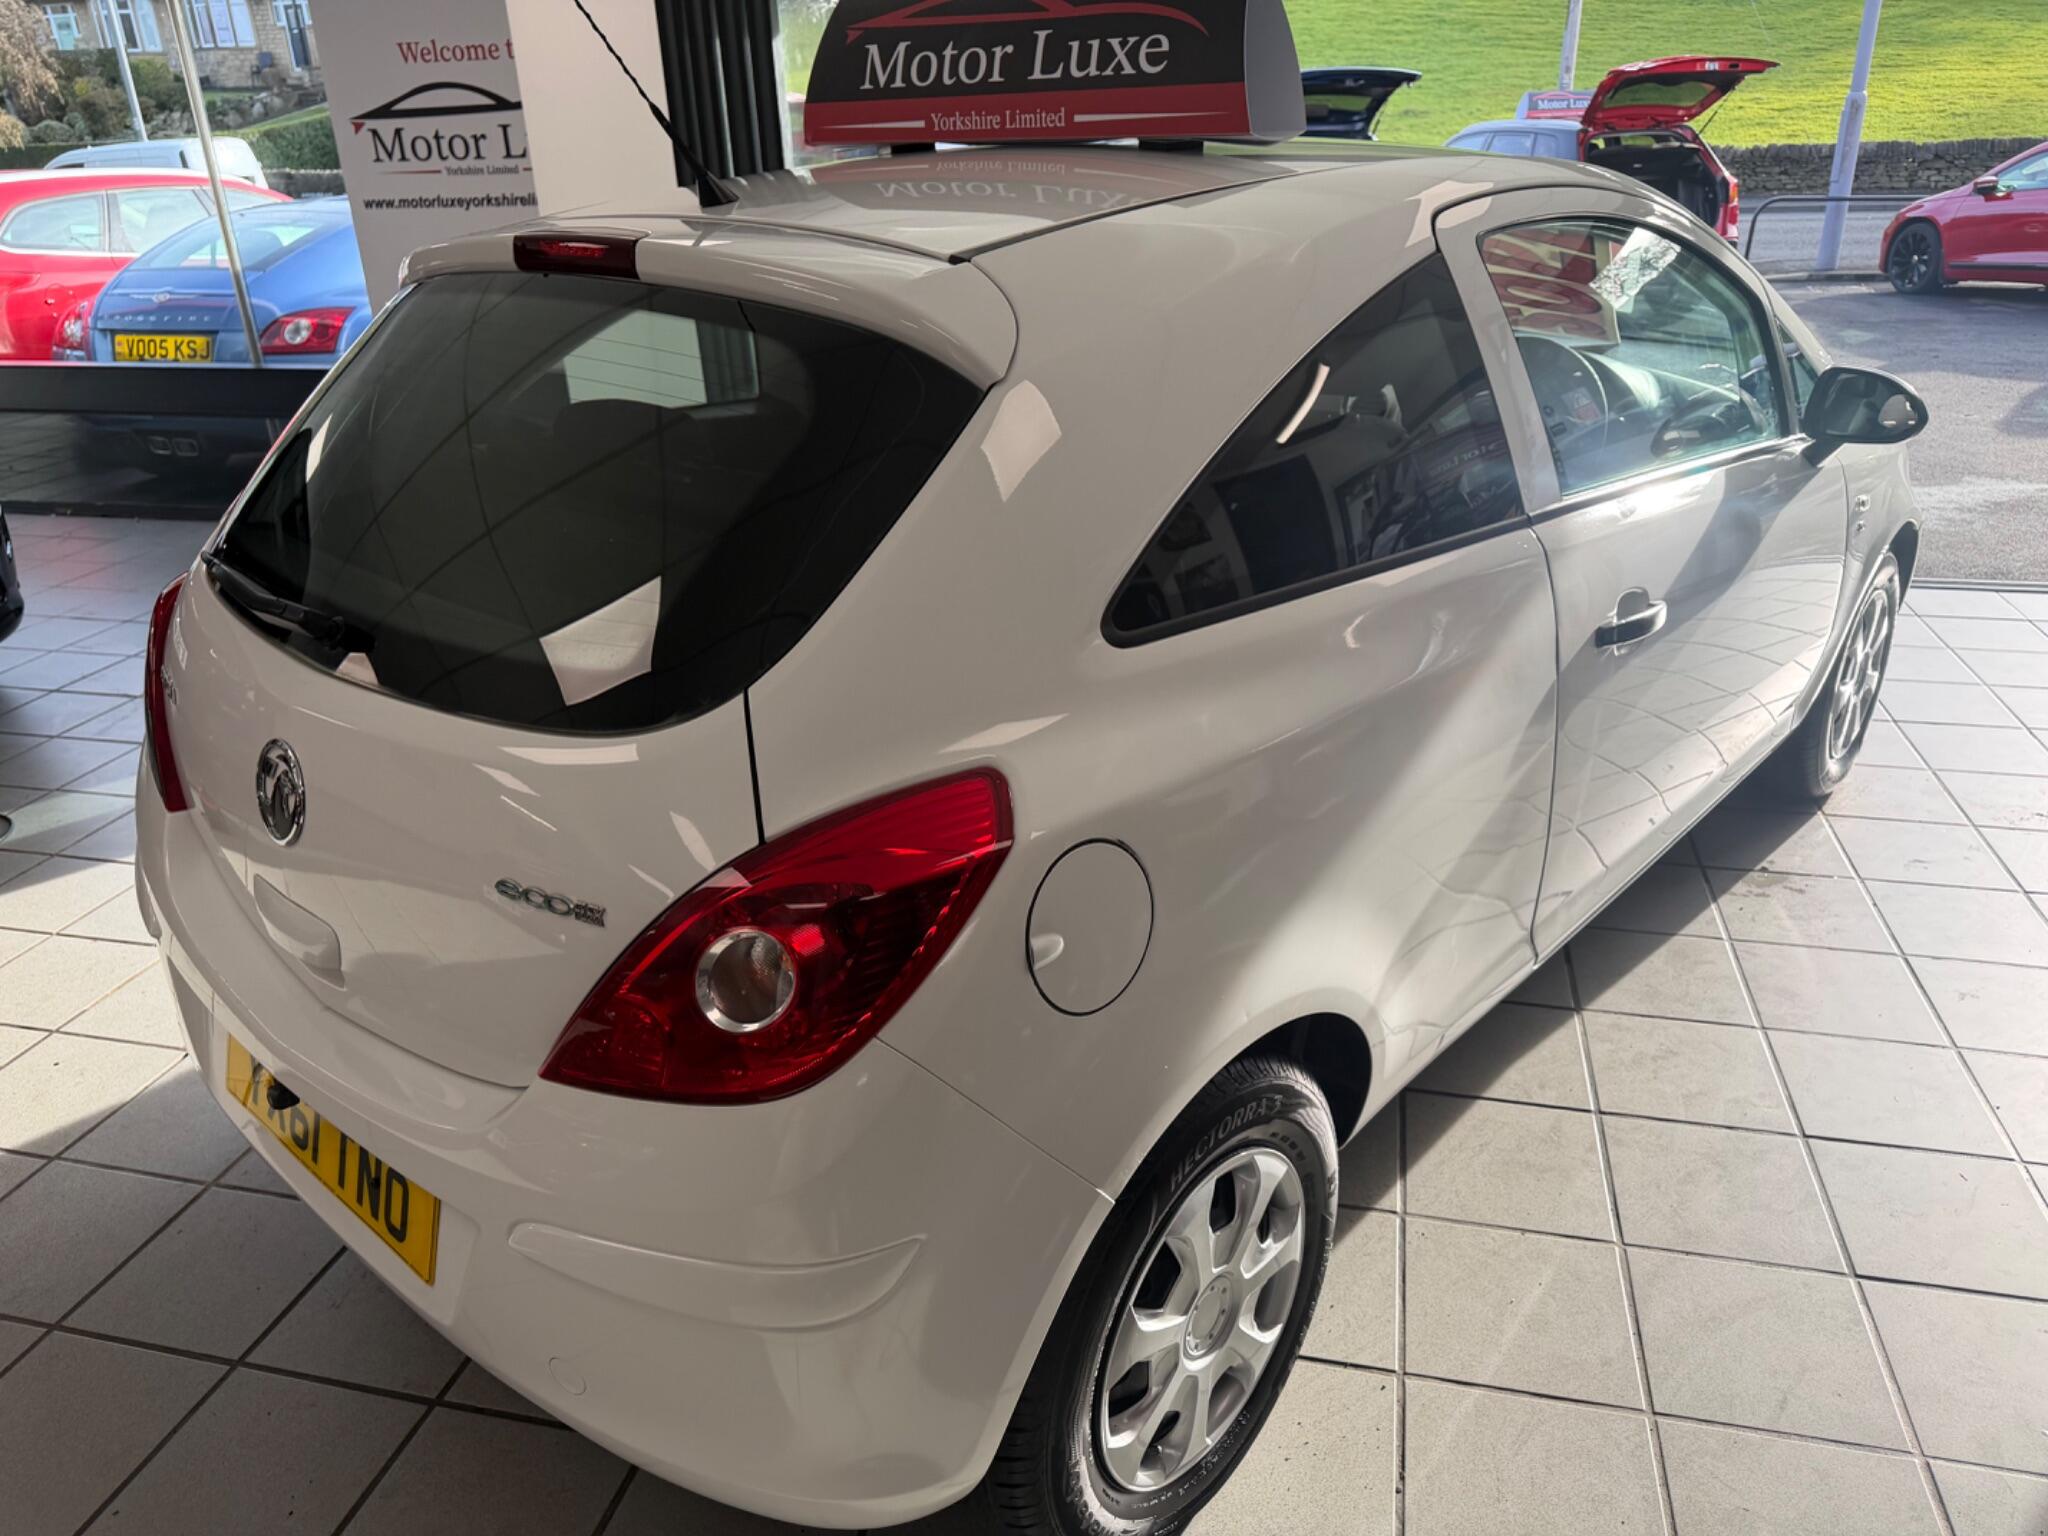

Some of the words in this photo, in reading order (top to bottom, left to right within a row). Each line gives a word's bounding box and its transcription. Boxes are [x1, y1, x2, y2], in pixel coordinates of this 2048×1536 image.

[396, 38, 500, 64] Welcome
[860, 41, 1014, 90] Motor
[1028, 29, 1170, 80] Luxe
[1537, 98, 1568, 110] Motor
[931, 111, 1000, 132] Yorkshire
[1005, 107, 1066, 129] Limited
[367, 127, 487, 163] Motor
[445, 166, 485, 176] Yorkshire
[487, 164, 519, 175] Limited
[174, 339, 211, 360] KSJ
[1170, 1098, 1268, 1192] HECTORRA
[336, 1132, 410, 1244] TNO
